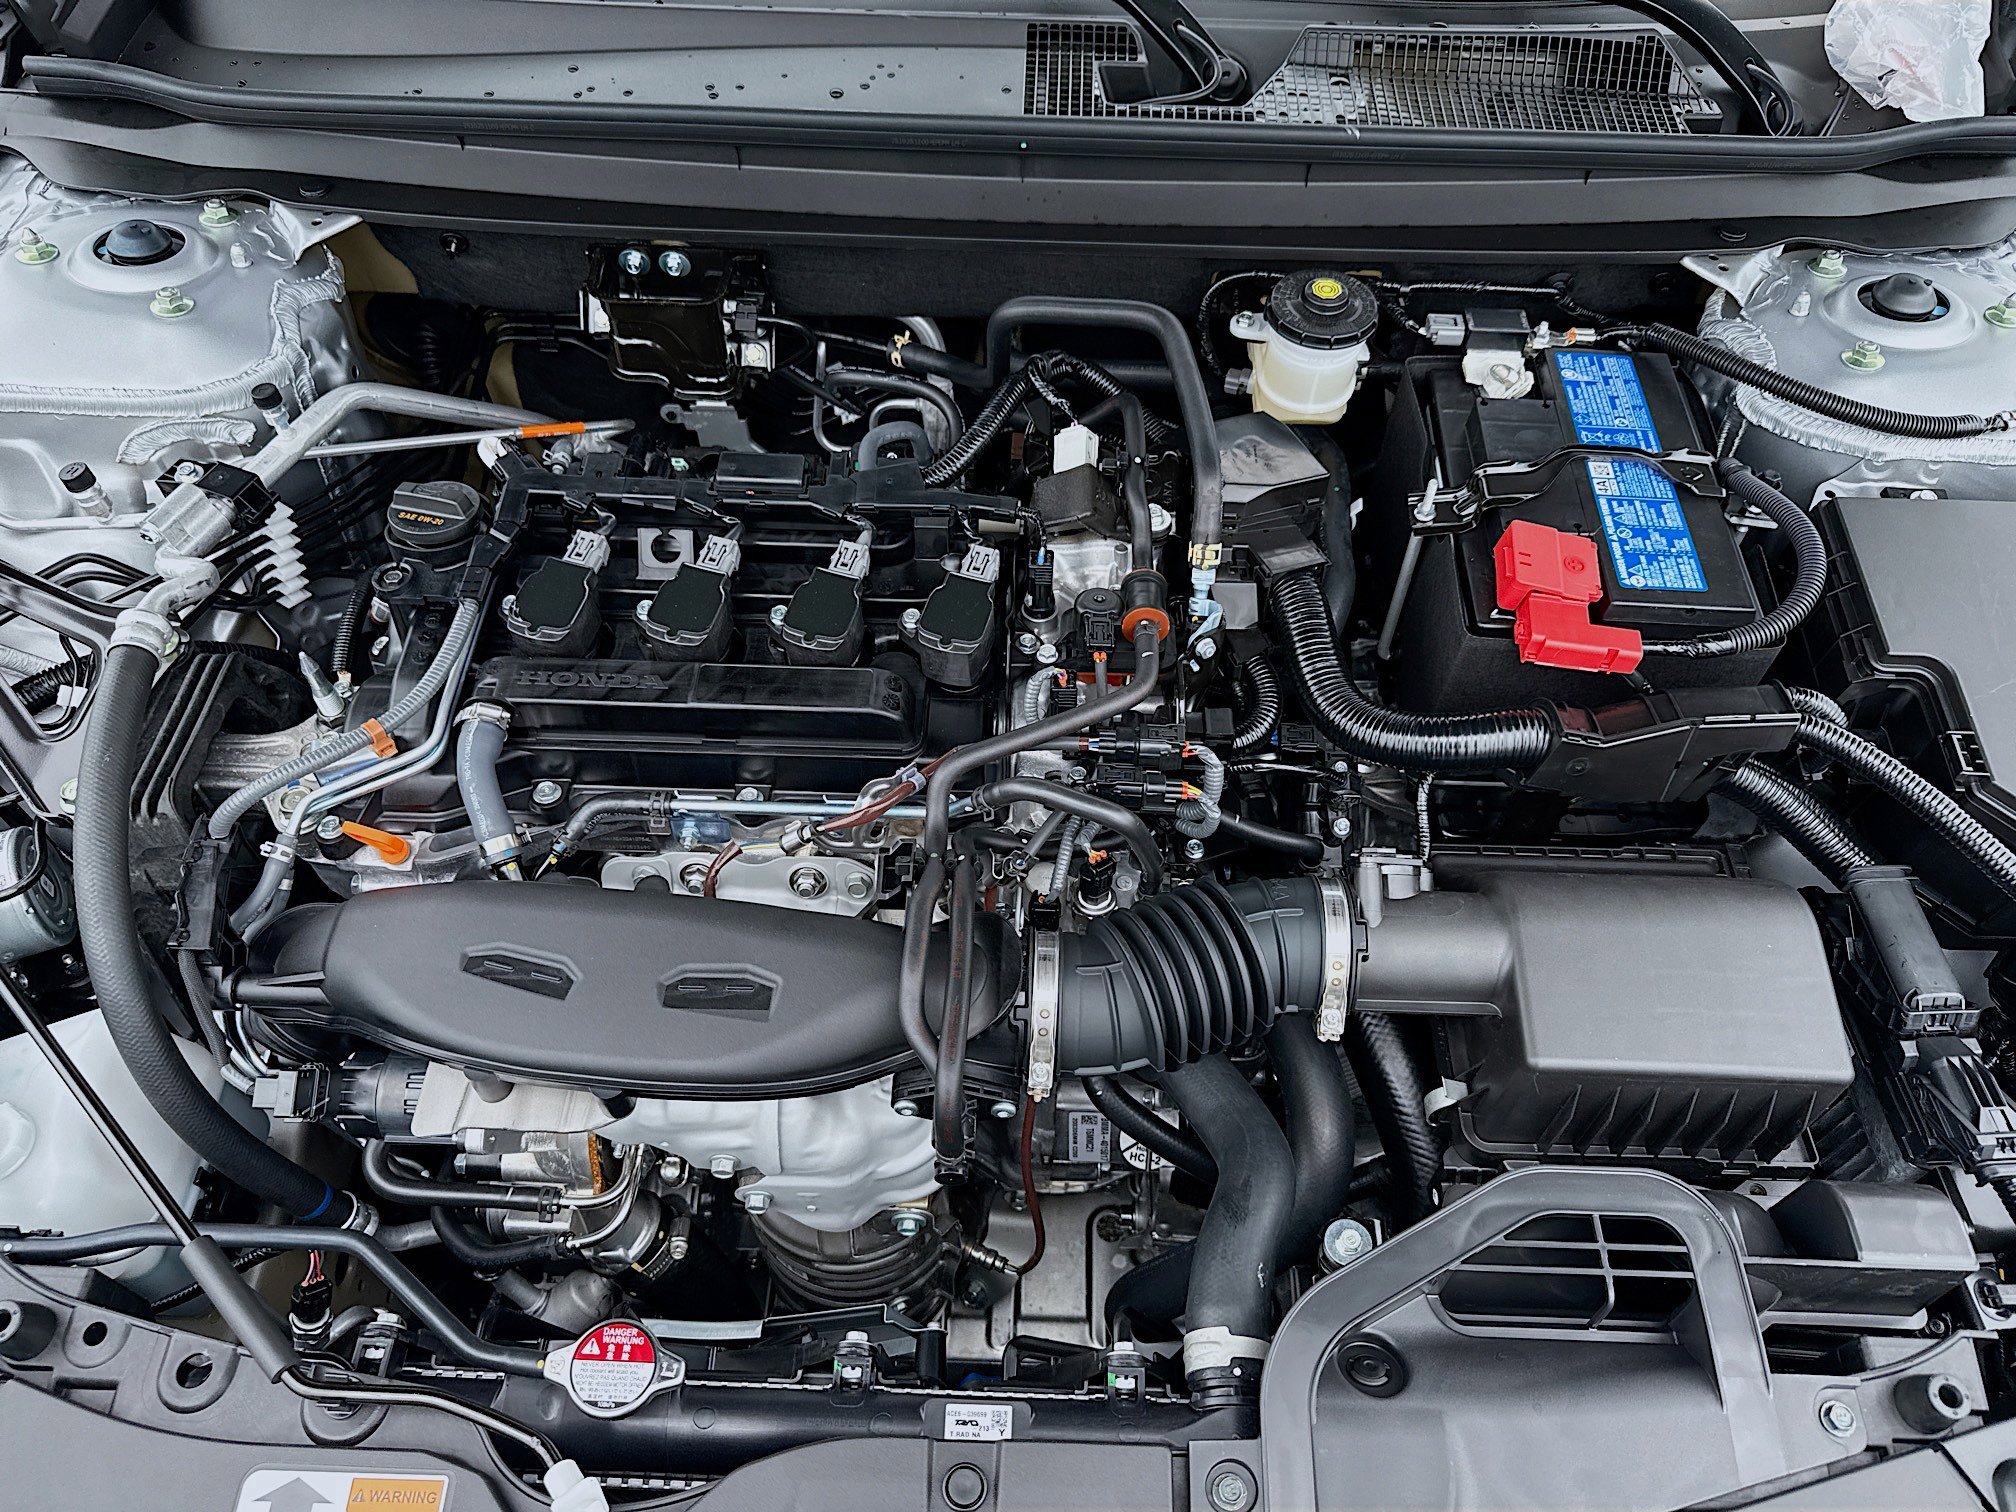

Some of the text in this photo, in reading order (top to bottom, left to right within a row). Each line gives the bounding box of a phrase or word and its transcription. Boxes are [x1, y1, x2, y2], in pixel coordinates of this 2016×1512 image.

[398, 511, 445, 526] SAE 0W-20
[517, 670, 669, 690] HONDA
[603, 1327, 639, 1337] DANGER
[602, 1335, 645, 1346] WARNUNG
[998, 1428, 1006, 1437] Y
[369, 1489, 438, 1504] WARNING
